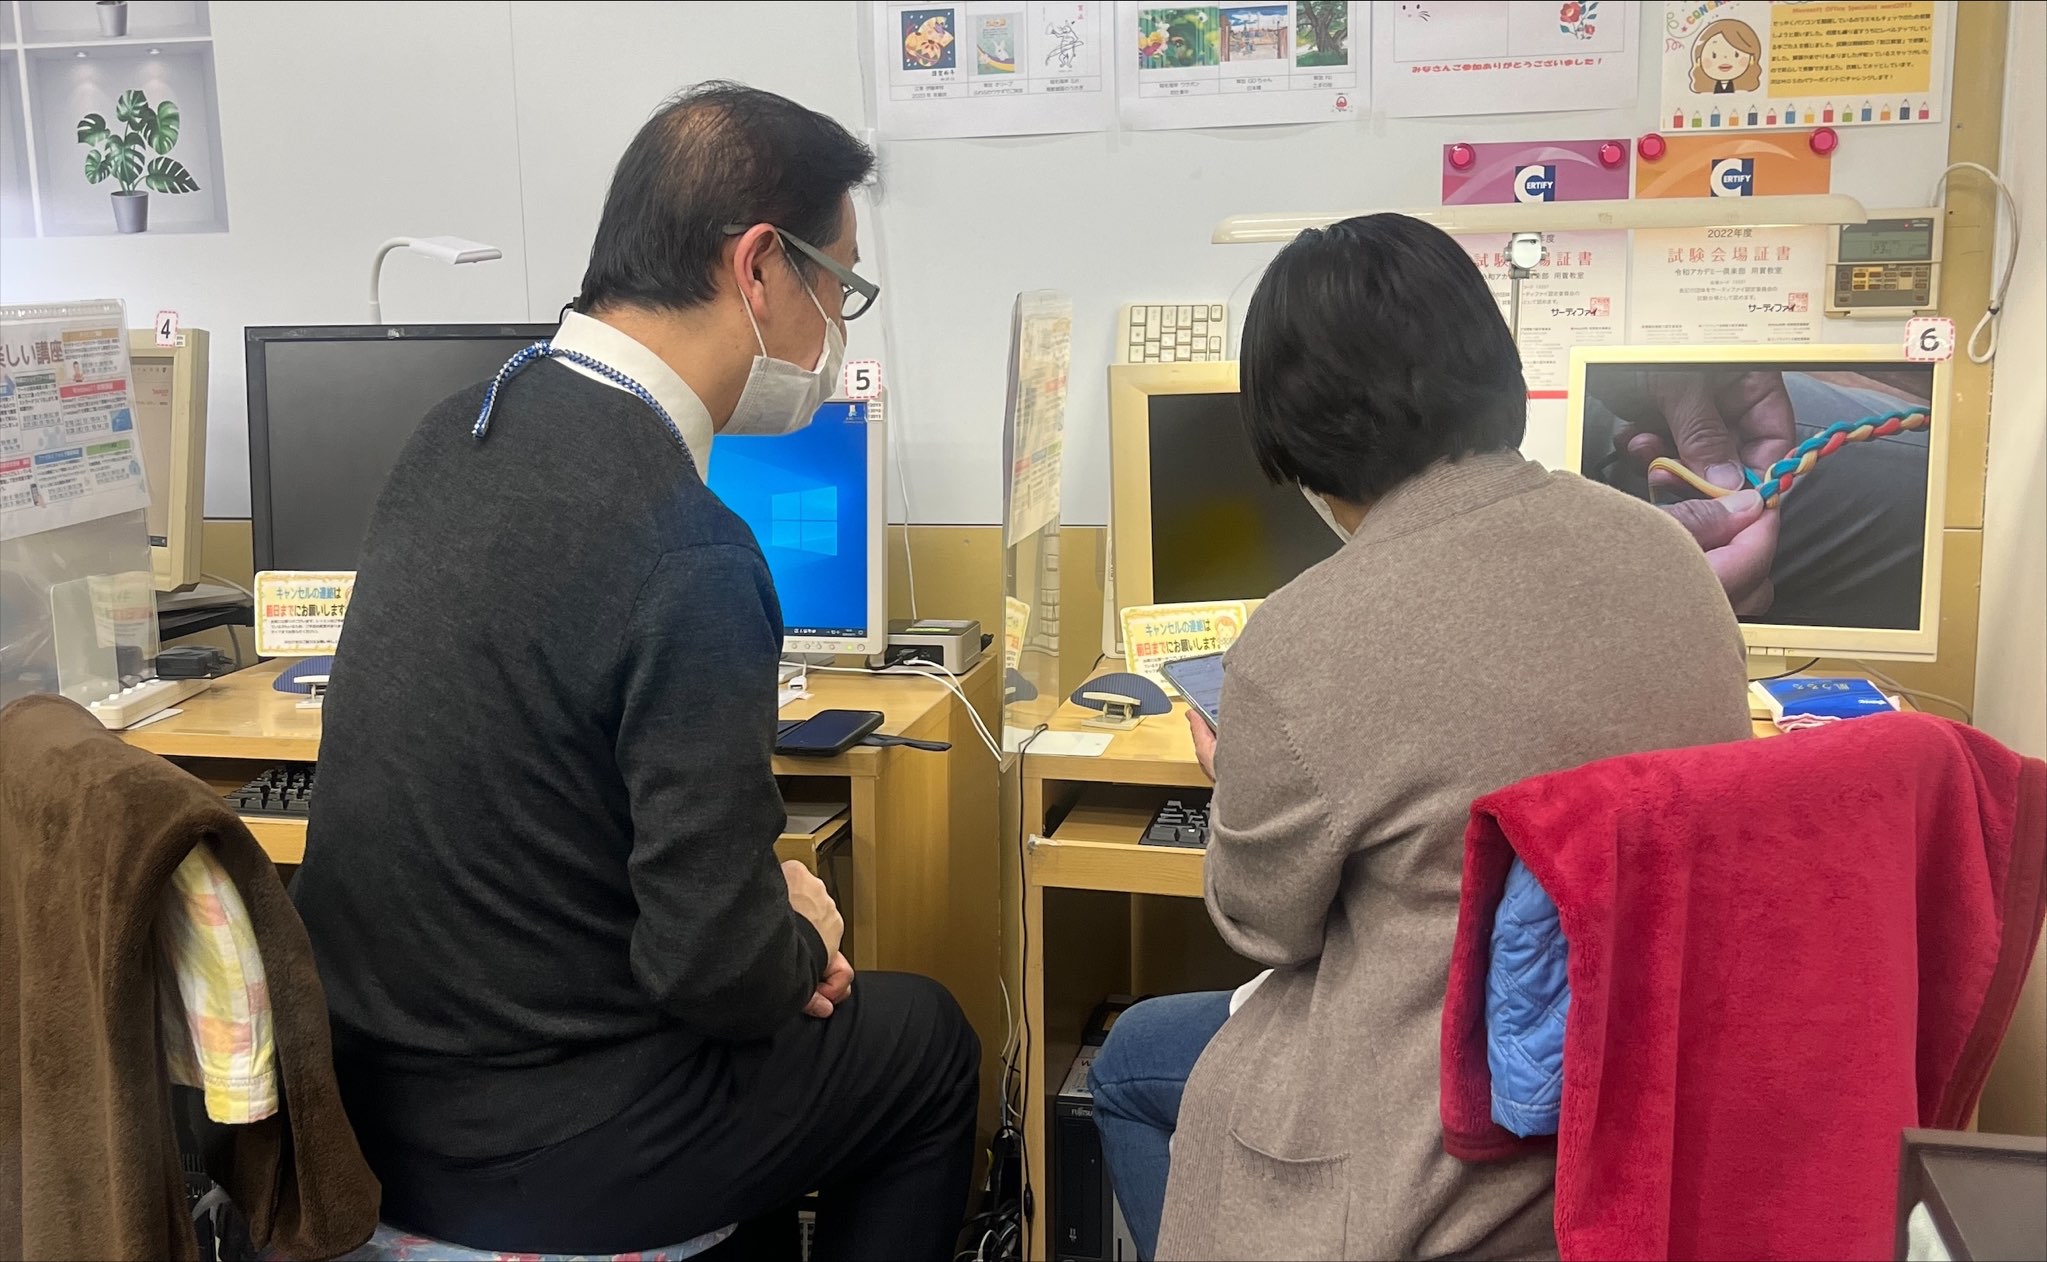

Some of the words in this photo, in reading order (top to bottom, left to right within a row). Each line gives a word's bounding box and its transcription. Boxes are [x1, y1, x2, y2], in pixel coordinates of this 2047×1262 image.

[1708, 228, 1753, 239] 2022年度
[1551, 308, 1598, 317] サーティファイ
[1748, 303, 1796, 313] サーティファイ
[161, 319, 171, 339] 4
[1920, 328, 1939, 352] 6
[856, 369, 870, 391] 5
[276, 587, 341, 600] キャンセルの連絡は
[1145, 619, 1211, 637] キャンセルの連絡は
